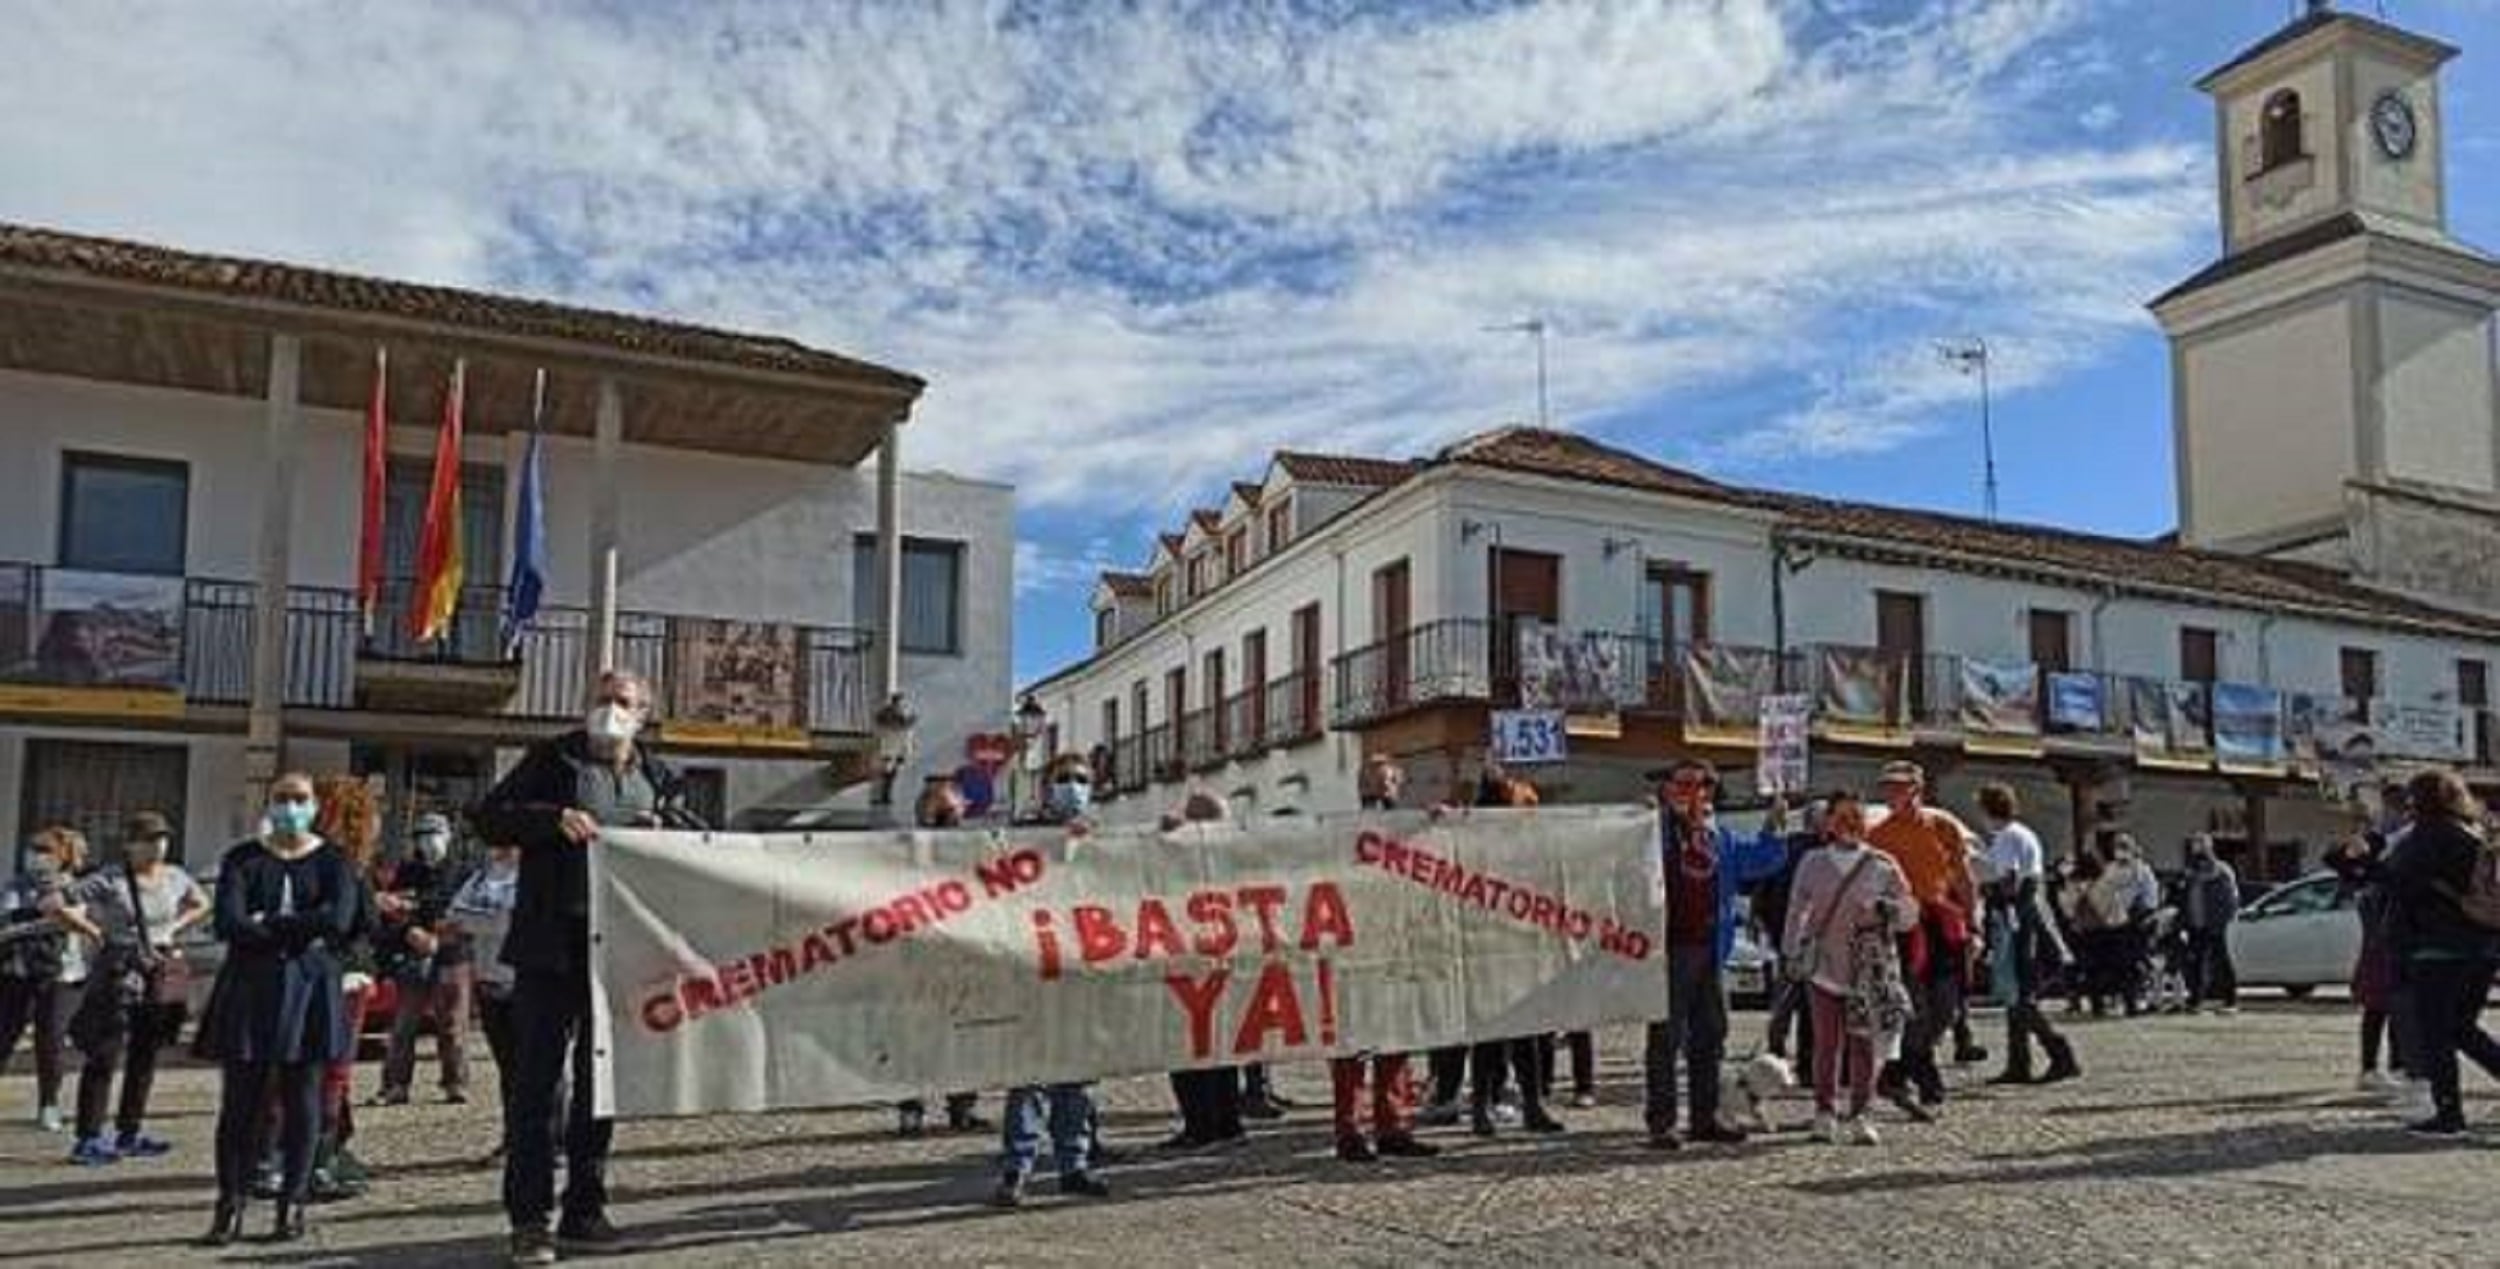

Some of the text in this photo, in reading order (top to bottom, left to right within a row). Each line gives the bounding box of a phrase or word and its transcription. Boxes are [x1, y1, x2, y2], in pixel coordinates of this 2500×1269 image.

[641, 849, 1046, 1033] CREMATORIO NO
[1032, 882, 1355, 979] ¡BASTA
[1355, 831, 1592, 941] CREMATORIO
[1598, 917, 1650, 961] NO
[1164, 961, 1337, 1060] YA!
